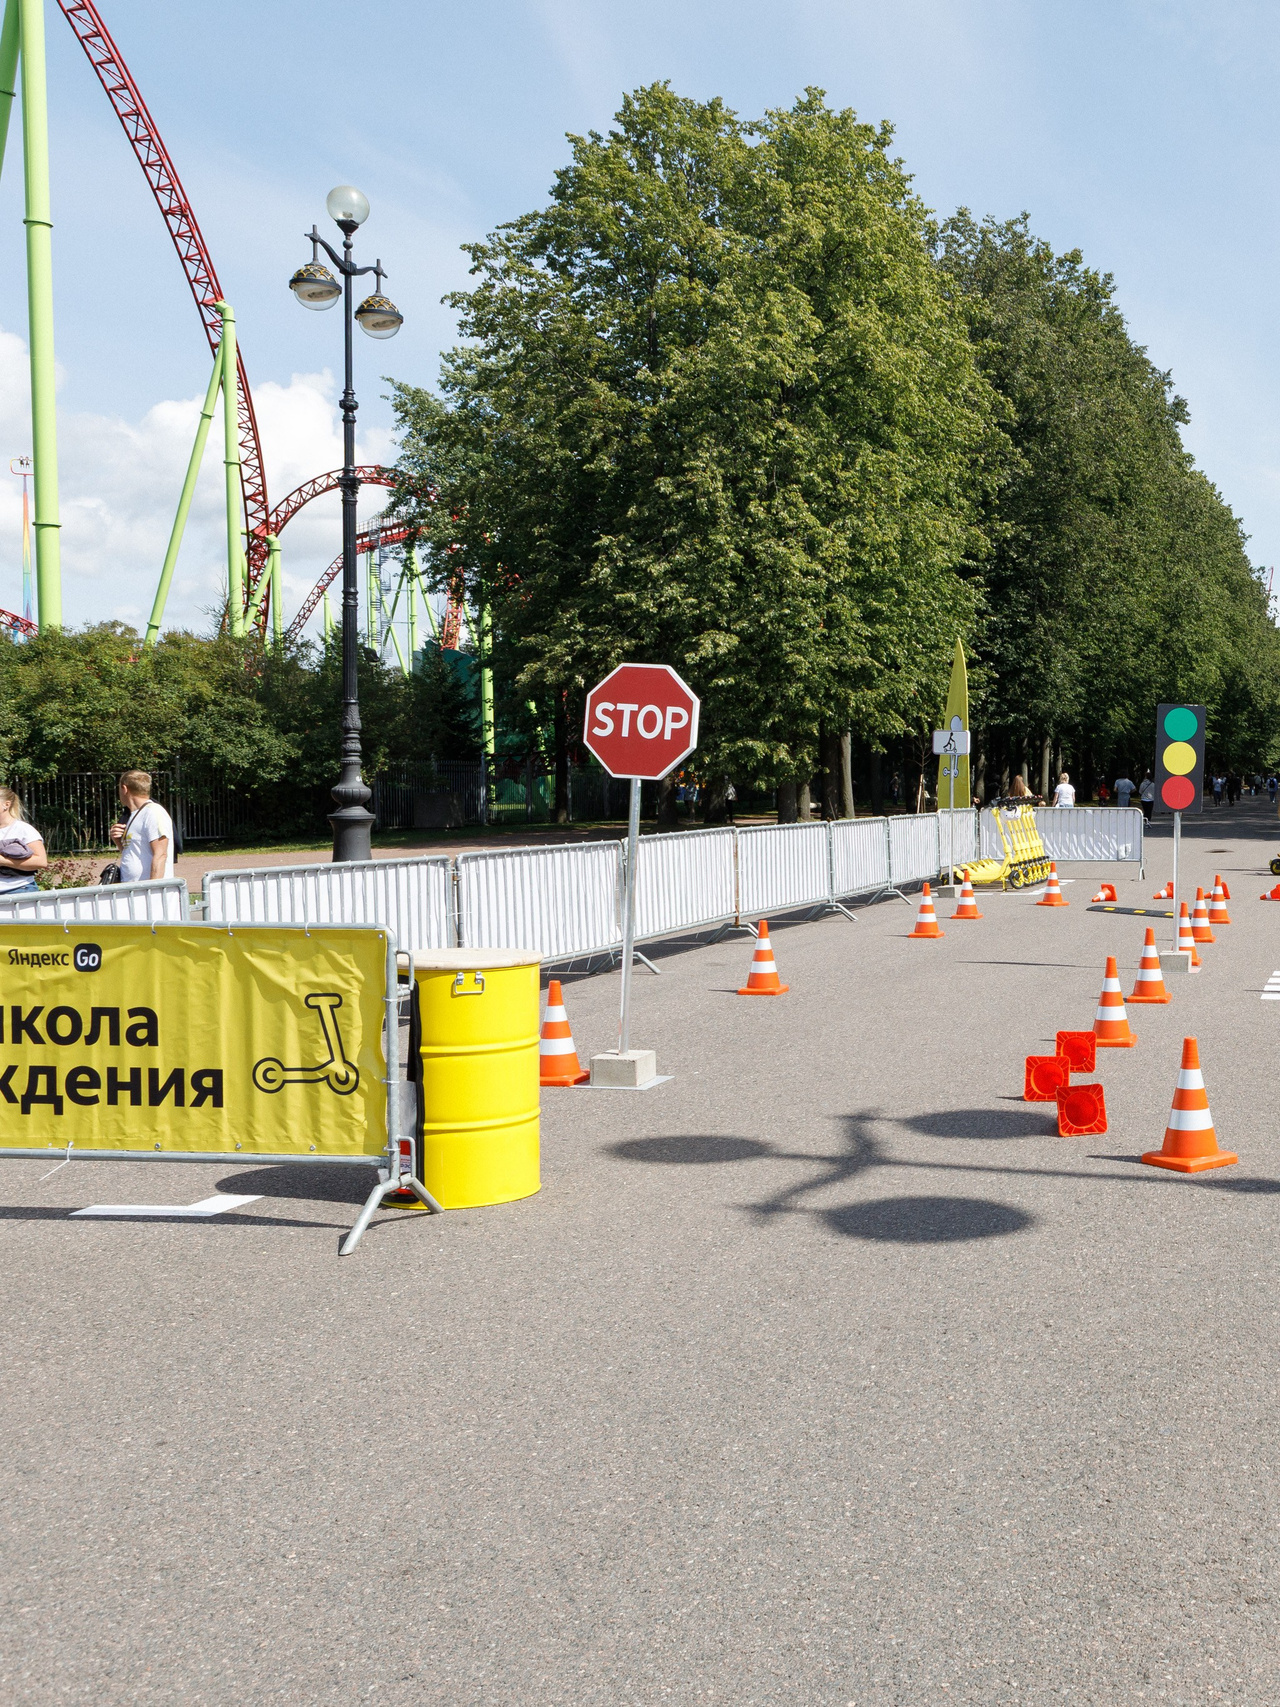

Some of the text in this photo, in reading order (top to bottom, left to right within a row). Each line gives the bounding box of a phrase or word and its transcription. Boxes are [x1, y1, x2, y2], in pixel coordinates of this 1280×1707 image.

[592, 702, 689, 740] STOP
[8, 947, 100, 968] Яндекс Go
[0, 1005, 158, 1046] кола
